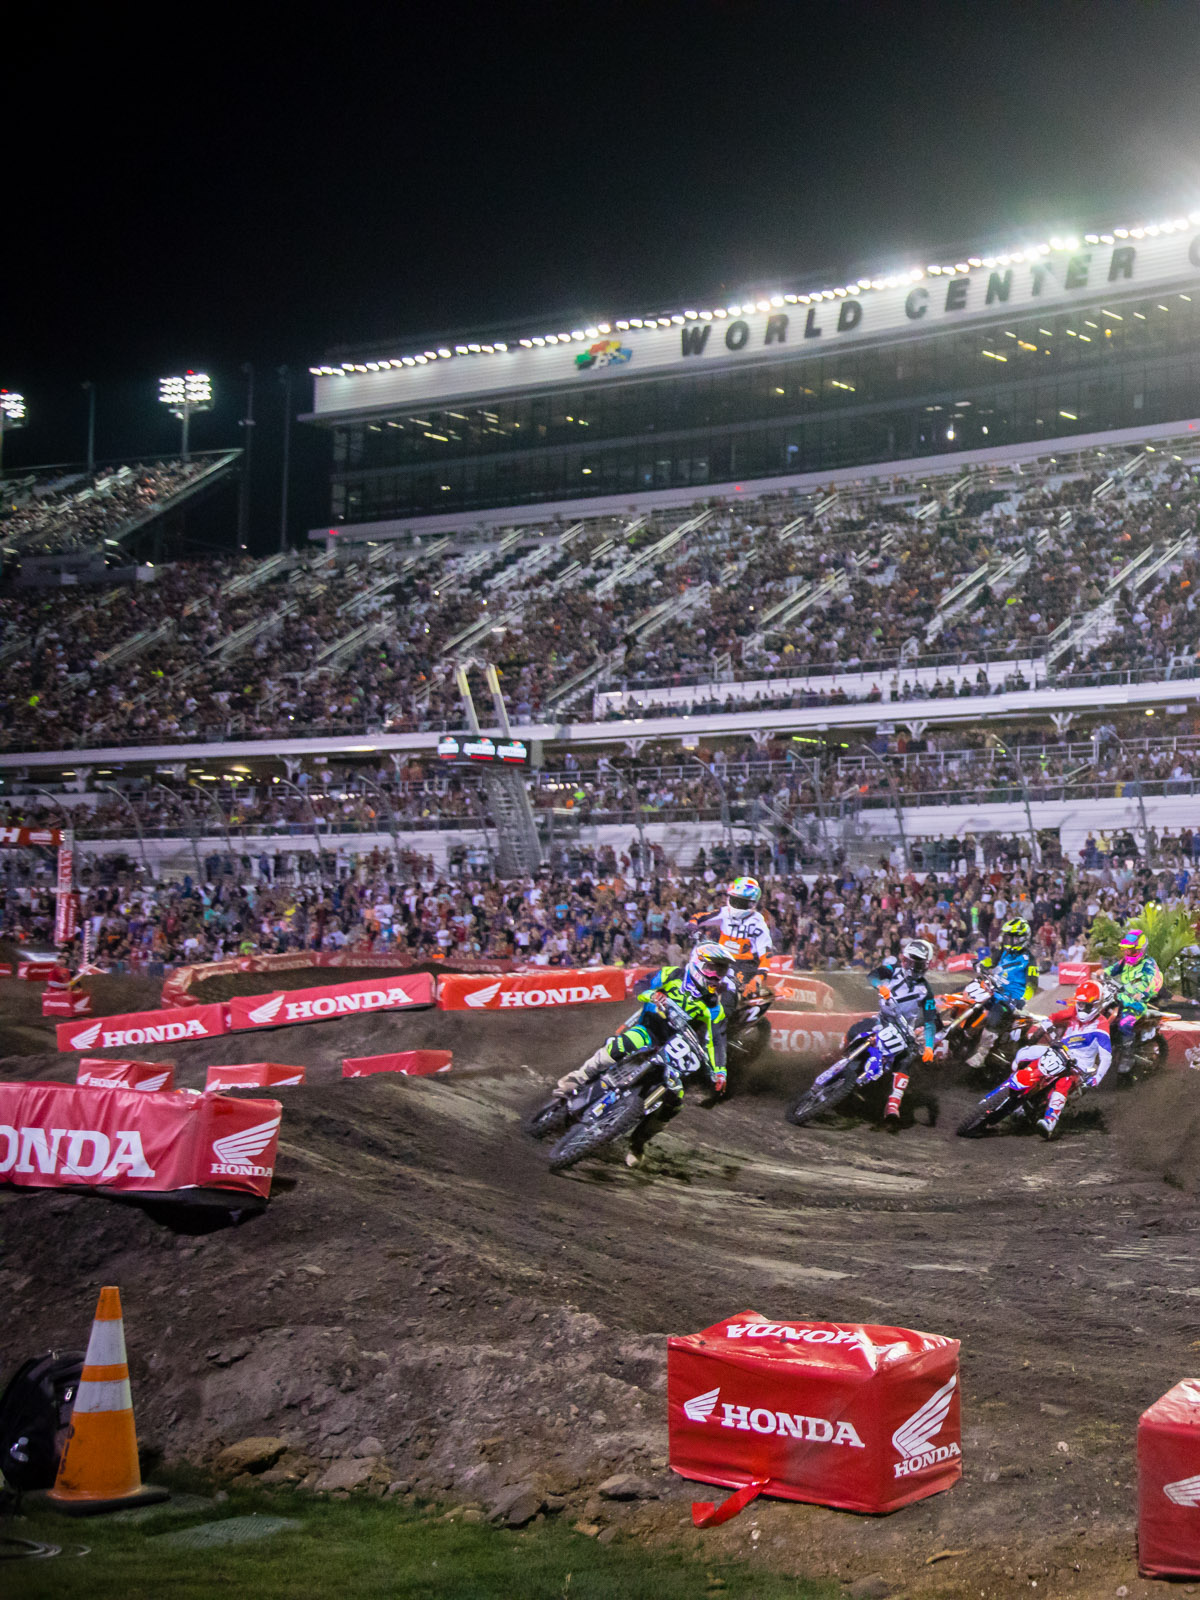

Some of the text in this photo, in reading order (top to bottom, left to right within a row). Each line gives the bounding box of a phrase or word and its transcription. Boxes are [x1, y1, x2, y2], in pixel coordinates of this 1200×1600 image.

[681, 300, 863, 357] WORLD
[905, 246, 1137, 320] CENTER
[286, 987, 414, 1020] HONDA
[500, 984, 612, 1007] HONDA
[102, 1019, 208, 1048] HONDA
[211, 1163, 273, 1177] HONDA
[721, 1402, 866, 1448] HONDA
[893, 1442, 961, 1478] HONDA
